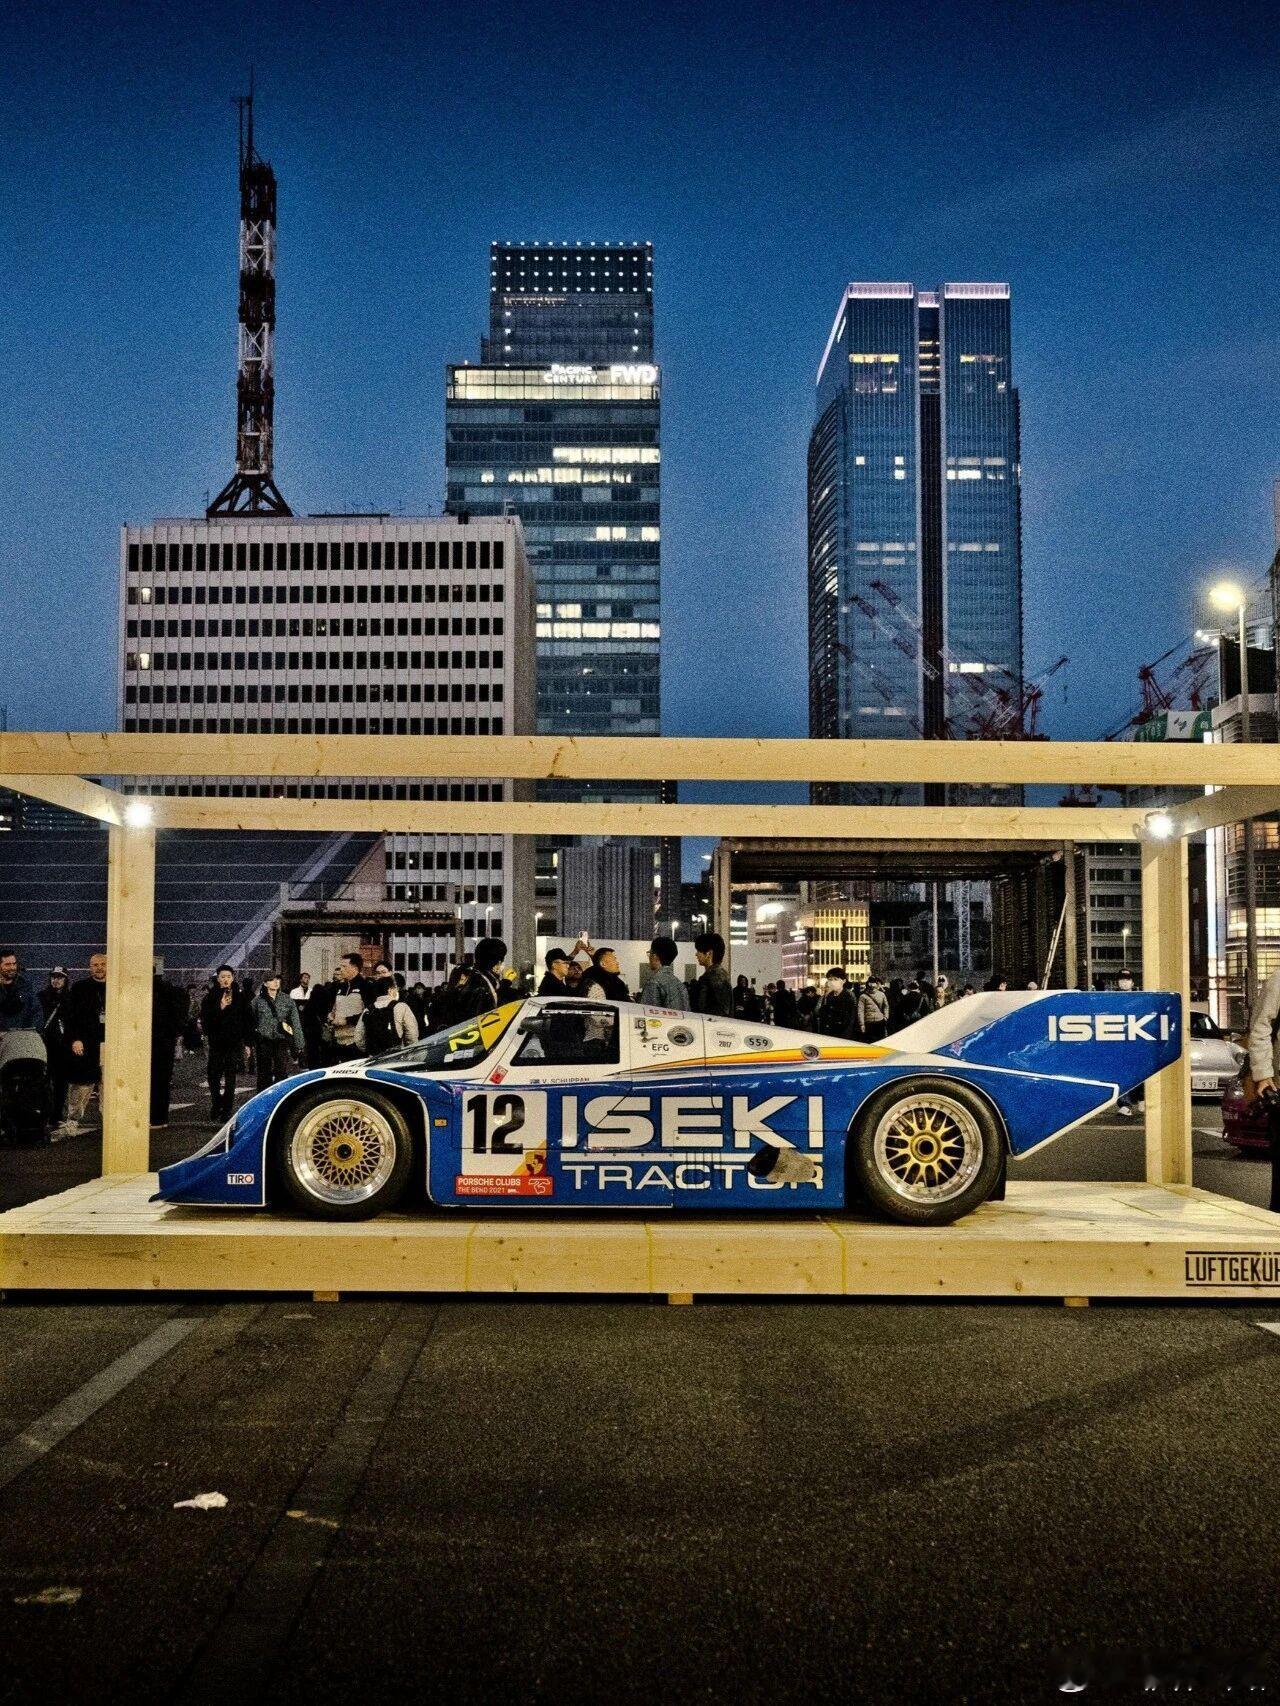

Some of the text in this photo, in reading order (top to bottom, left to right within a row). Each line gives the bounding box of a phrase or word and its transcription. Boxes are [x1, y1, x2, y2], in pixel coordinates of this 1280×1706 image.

[610, 364, 658, 384] FWD
[1048, 1014, 1168, 1041] ISEKI
[749, 1037, 769, 1047] 559
[467, 1094, 525, 1154] 12
[562, 1095, 824, 1148] ISEKI
[458, 1178, 521, 1187] PORSCHE CLUBS
[458, 1186, 471, 1194] THE
[489, 1186, 505, 1194] 2021
